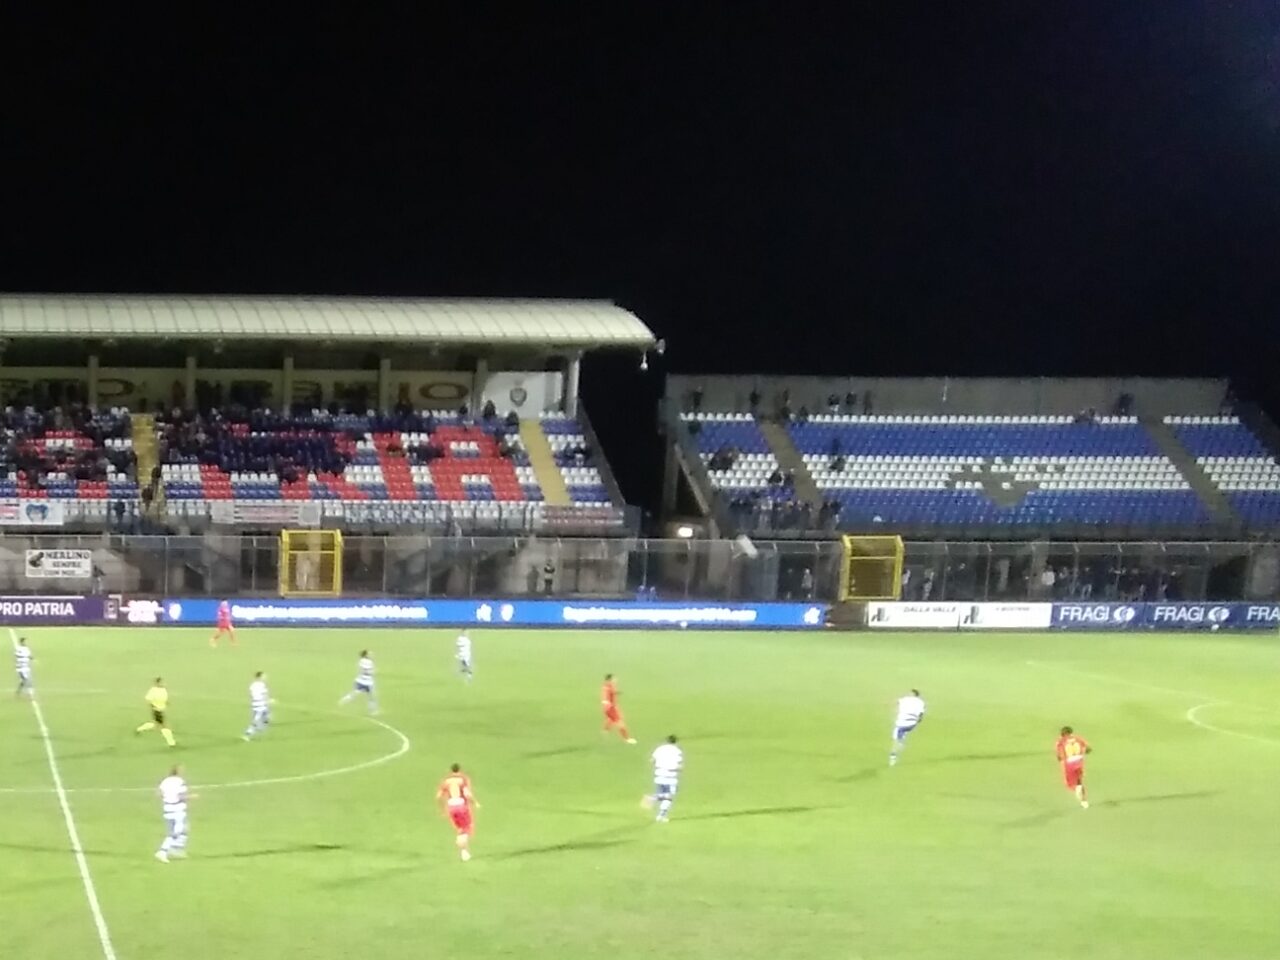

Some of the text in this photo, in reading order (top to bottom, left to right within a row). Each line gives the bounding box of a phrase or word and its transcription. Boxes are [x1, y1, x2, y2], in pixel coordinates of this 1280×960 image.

[25, 602, 75, 615] PATRIA
[1059, 606, 1110, 621] FRAGI
[1153, 606, 1205, 622] FRAGI
